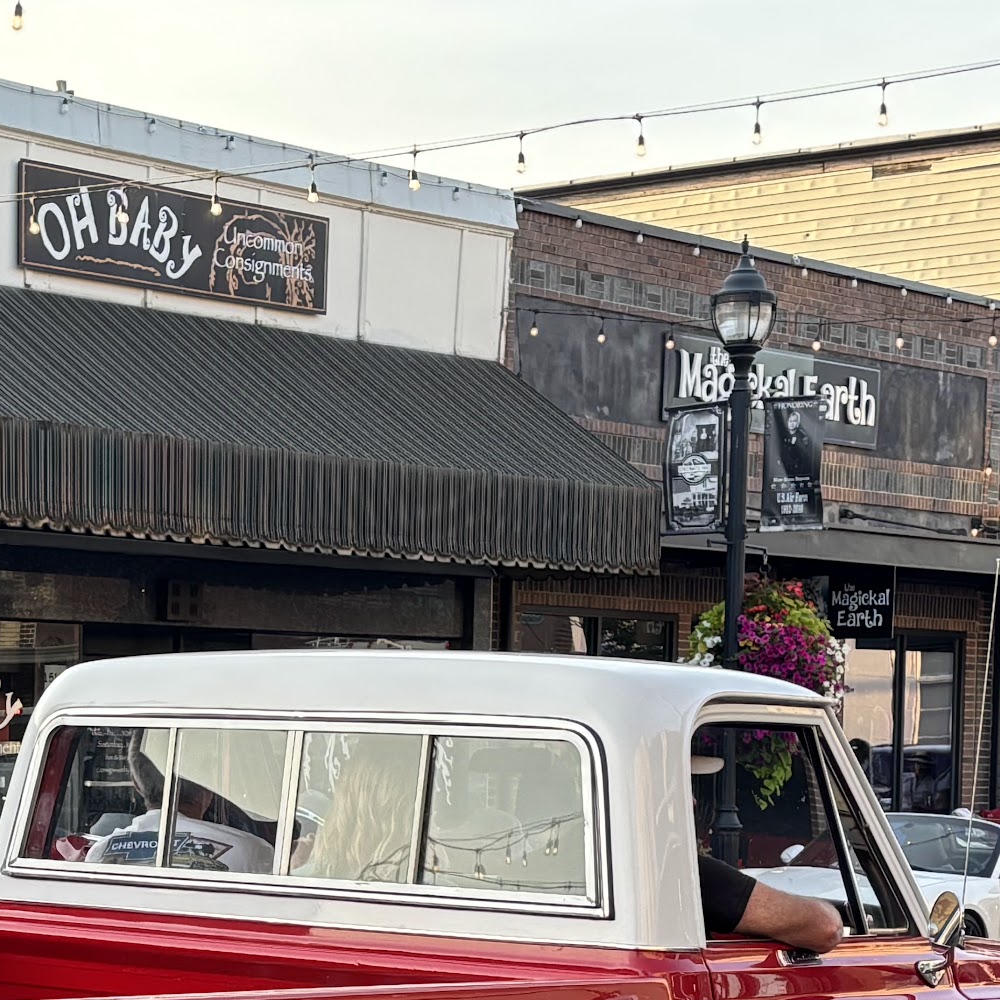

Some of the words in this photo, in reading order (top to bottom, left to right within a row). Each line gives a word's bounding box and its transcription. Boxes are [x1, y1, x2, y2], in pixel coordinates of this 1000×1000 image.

[37, 186, 99, 260] OH
[106, 188, 202, 279] BABY
[224, 226, 303, 256] Uncommon
[214, 247, 313, 283] Consignments
[709, 346, 731, 368] the
[803, 375, 876, 427] Earth
[831, 588, 891, 612] Magickal
[836, 608, 884, 629] Earth
